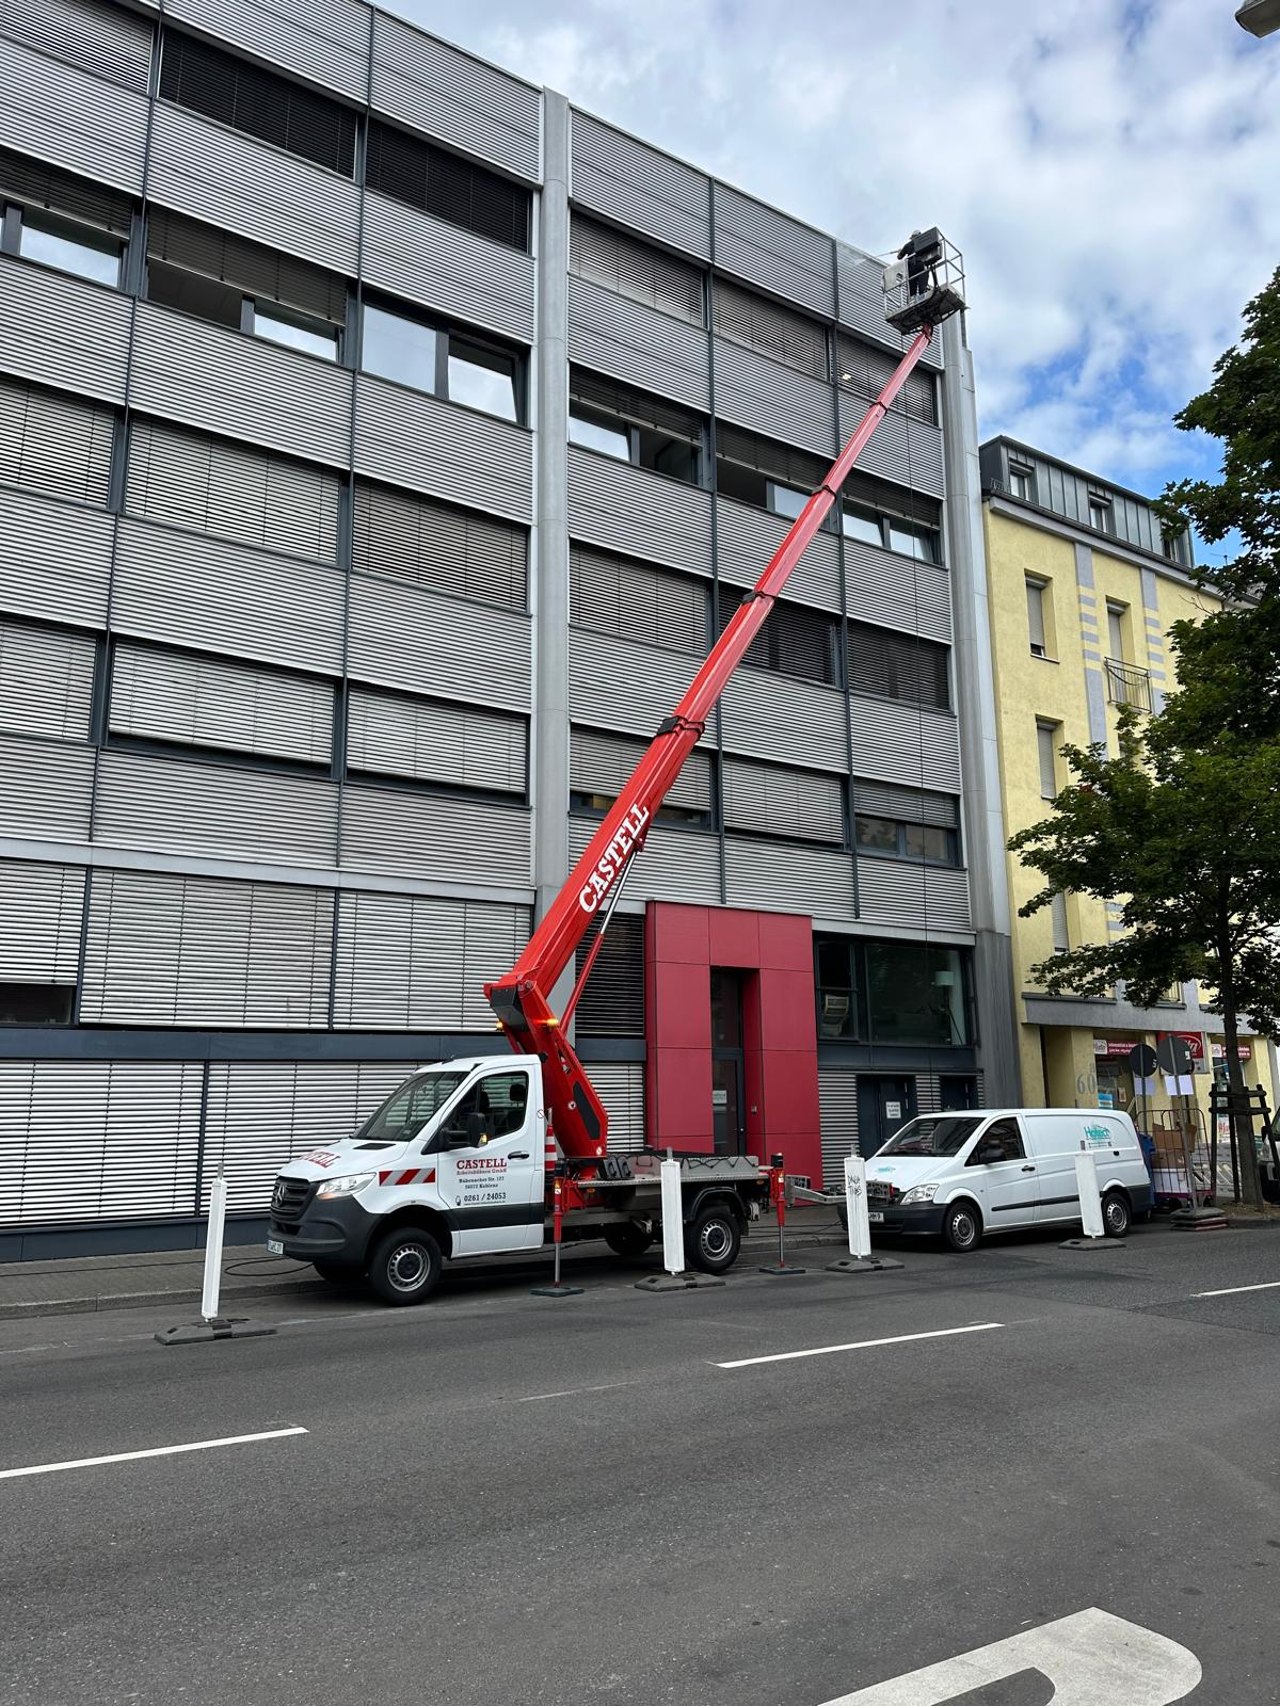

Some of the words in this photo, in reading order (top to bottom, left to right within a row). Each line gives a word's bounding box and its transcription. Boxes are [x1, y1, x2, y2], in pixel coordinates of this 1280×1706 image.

[579, 803, 650, 913] CASTELL
[1077, 1073, 1097, 1095] 60
[456, 1158, 507, 1170] CASTELL
[464, 1194, 480, 1202] 0261
[481, 1193, 486, 1201] /
[486, 1192, 507, 1201] 24053
